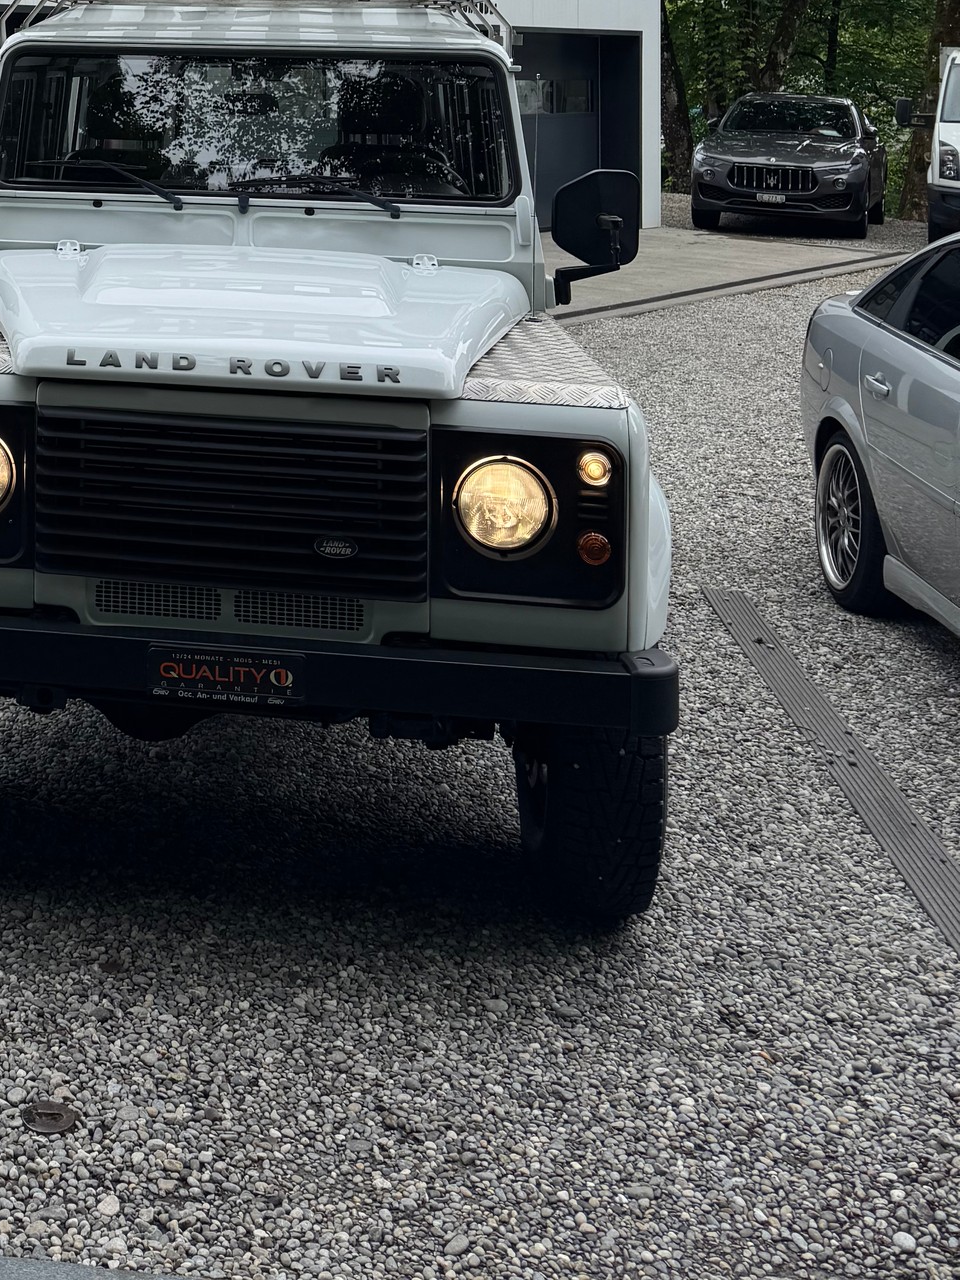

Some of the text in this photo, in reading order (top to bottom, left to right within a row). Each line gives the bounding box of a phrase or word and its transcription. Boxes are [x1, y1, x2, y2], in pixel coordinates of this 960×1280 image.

[66, 348, 401, 384] LAND ROVER
[194, 654, 224, 662] MONATE
[160, 662, 267, 684] QUALITY
[160, 680, 292, 696] GARANTIE
[178, 690, 195, 698] Occ.
[196, 691, 210, 699] An-
[212, 693, 227, 701] und
[228, 694, 259, 703] Verkauf
